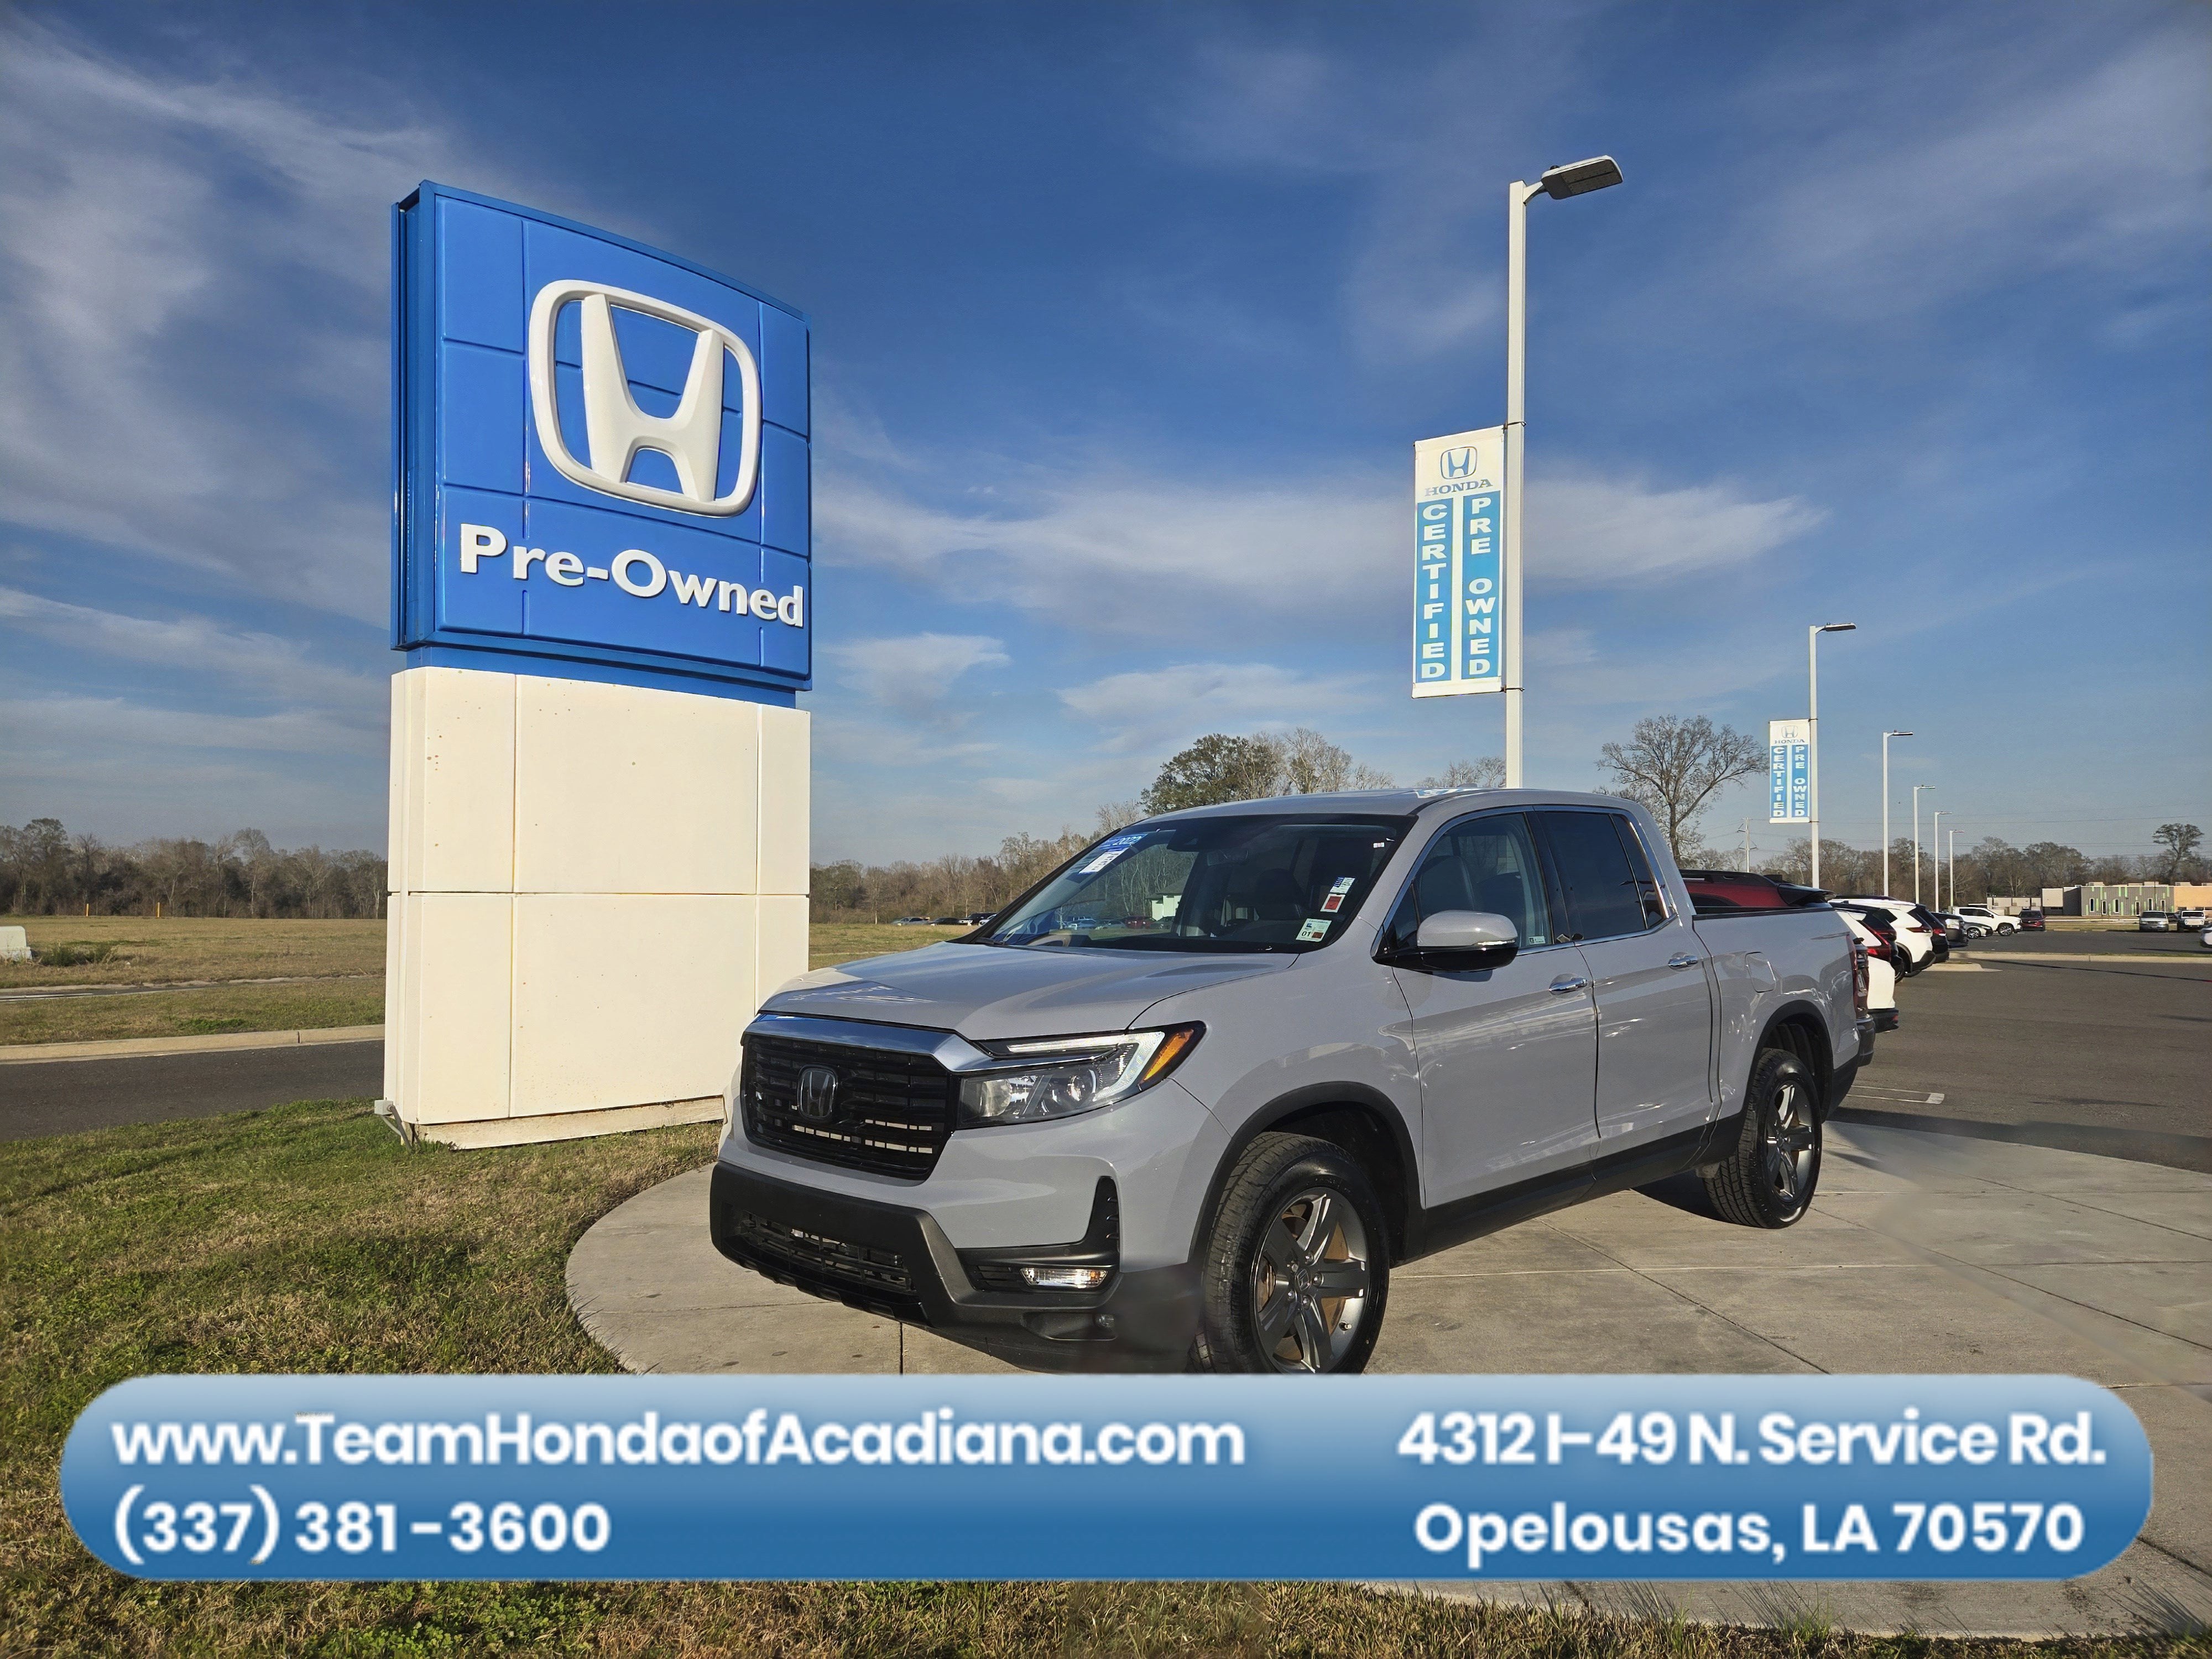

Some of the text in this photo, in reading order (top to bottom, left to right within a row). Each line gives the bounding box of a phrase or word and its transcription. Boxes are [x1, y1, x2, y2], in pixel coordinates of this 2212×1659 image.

[1425, 478, 1493, 497] HONDA
[460, 523, 804, 628] Pre-Owned
[1421, 503, 1448, 680] CERTIFIED
[1465, 497, 1496, 676] PRE OWNED
[1773, 747, 1785, 817] CERTIFIED
[1793, 746, 1807, 817] PRE OWNED
